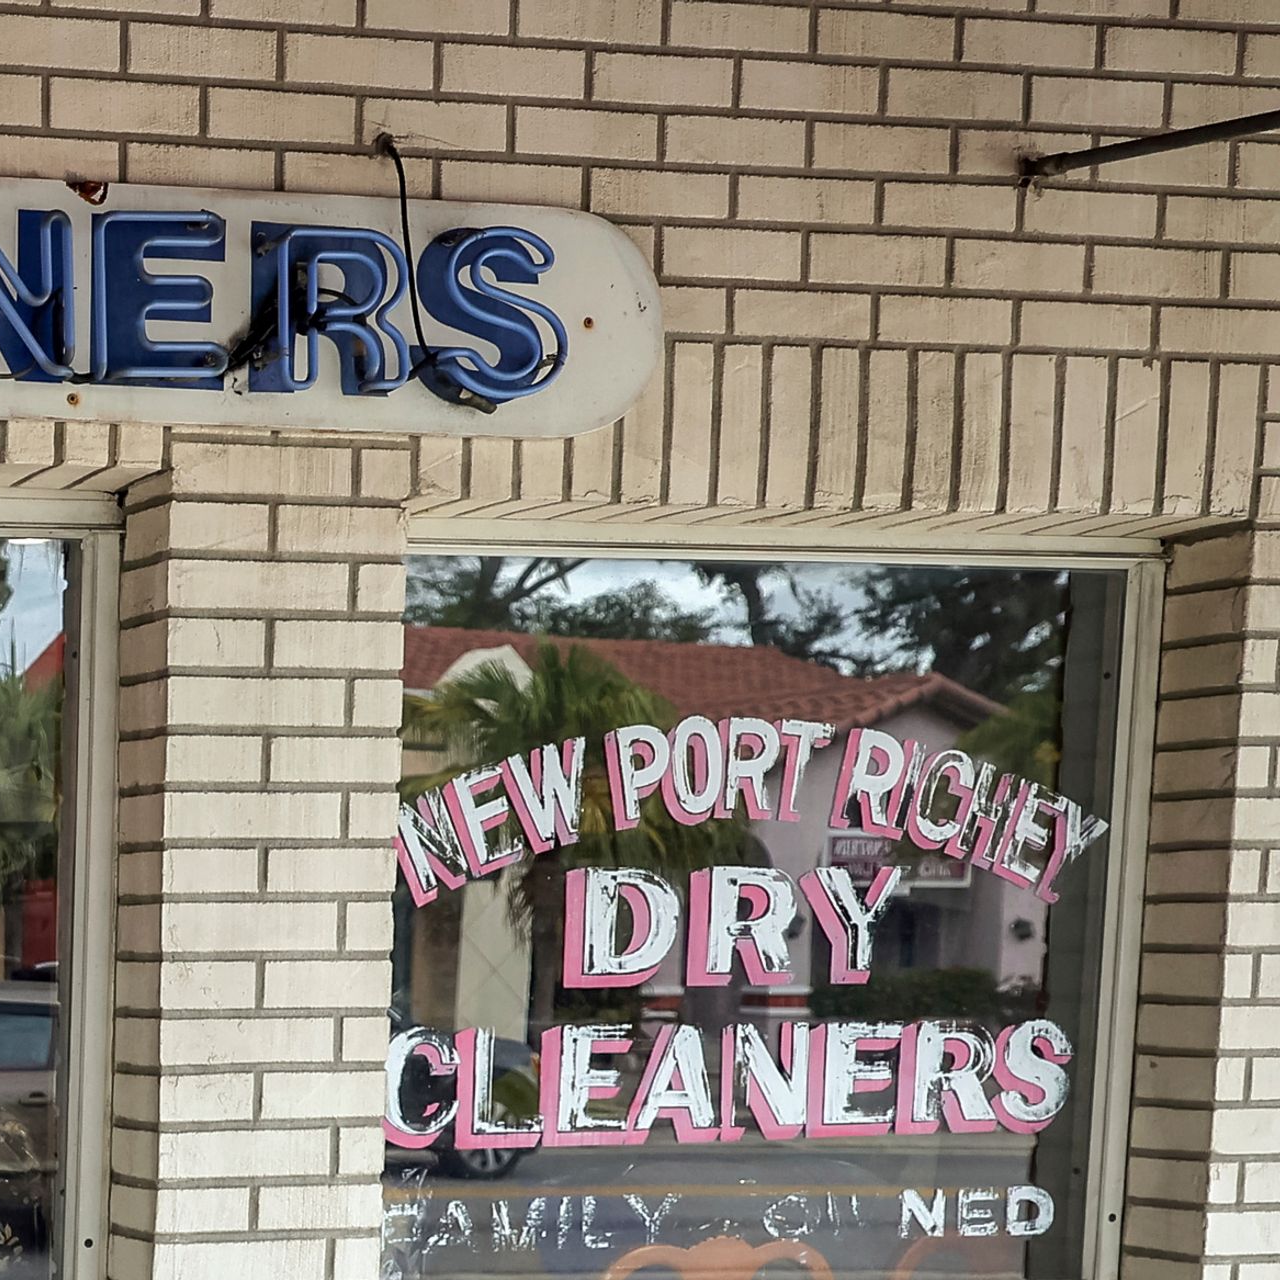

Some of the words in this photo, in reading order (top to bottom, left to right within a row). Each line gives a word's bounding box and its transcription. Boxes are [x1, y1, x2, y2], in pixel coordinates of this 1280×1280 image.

[392, 736, 586, 908] NEW
[603, 715, 836, 832] PORT
[829, 728, 1109, 904] RICHEY
[563, 866, 911, 989] DRY
[383, 1018, 1074, 1150] CLEANERS
